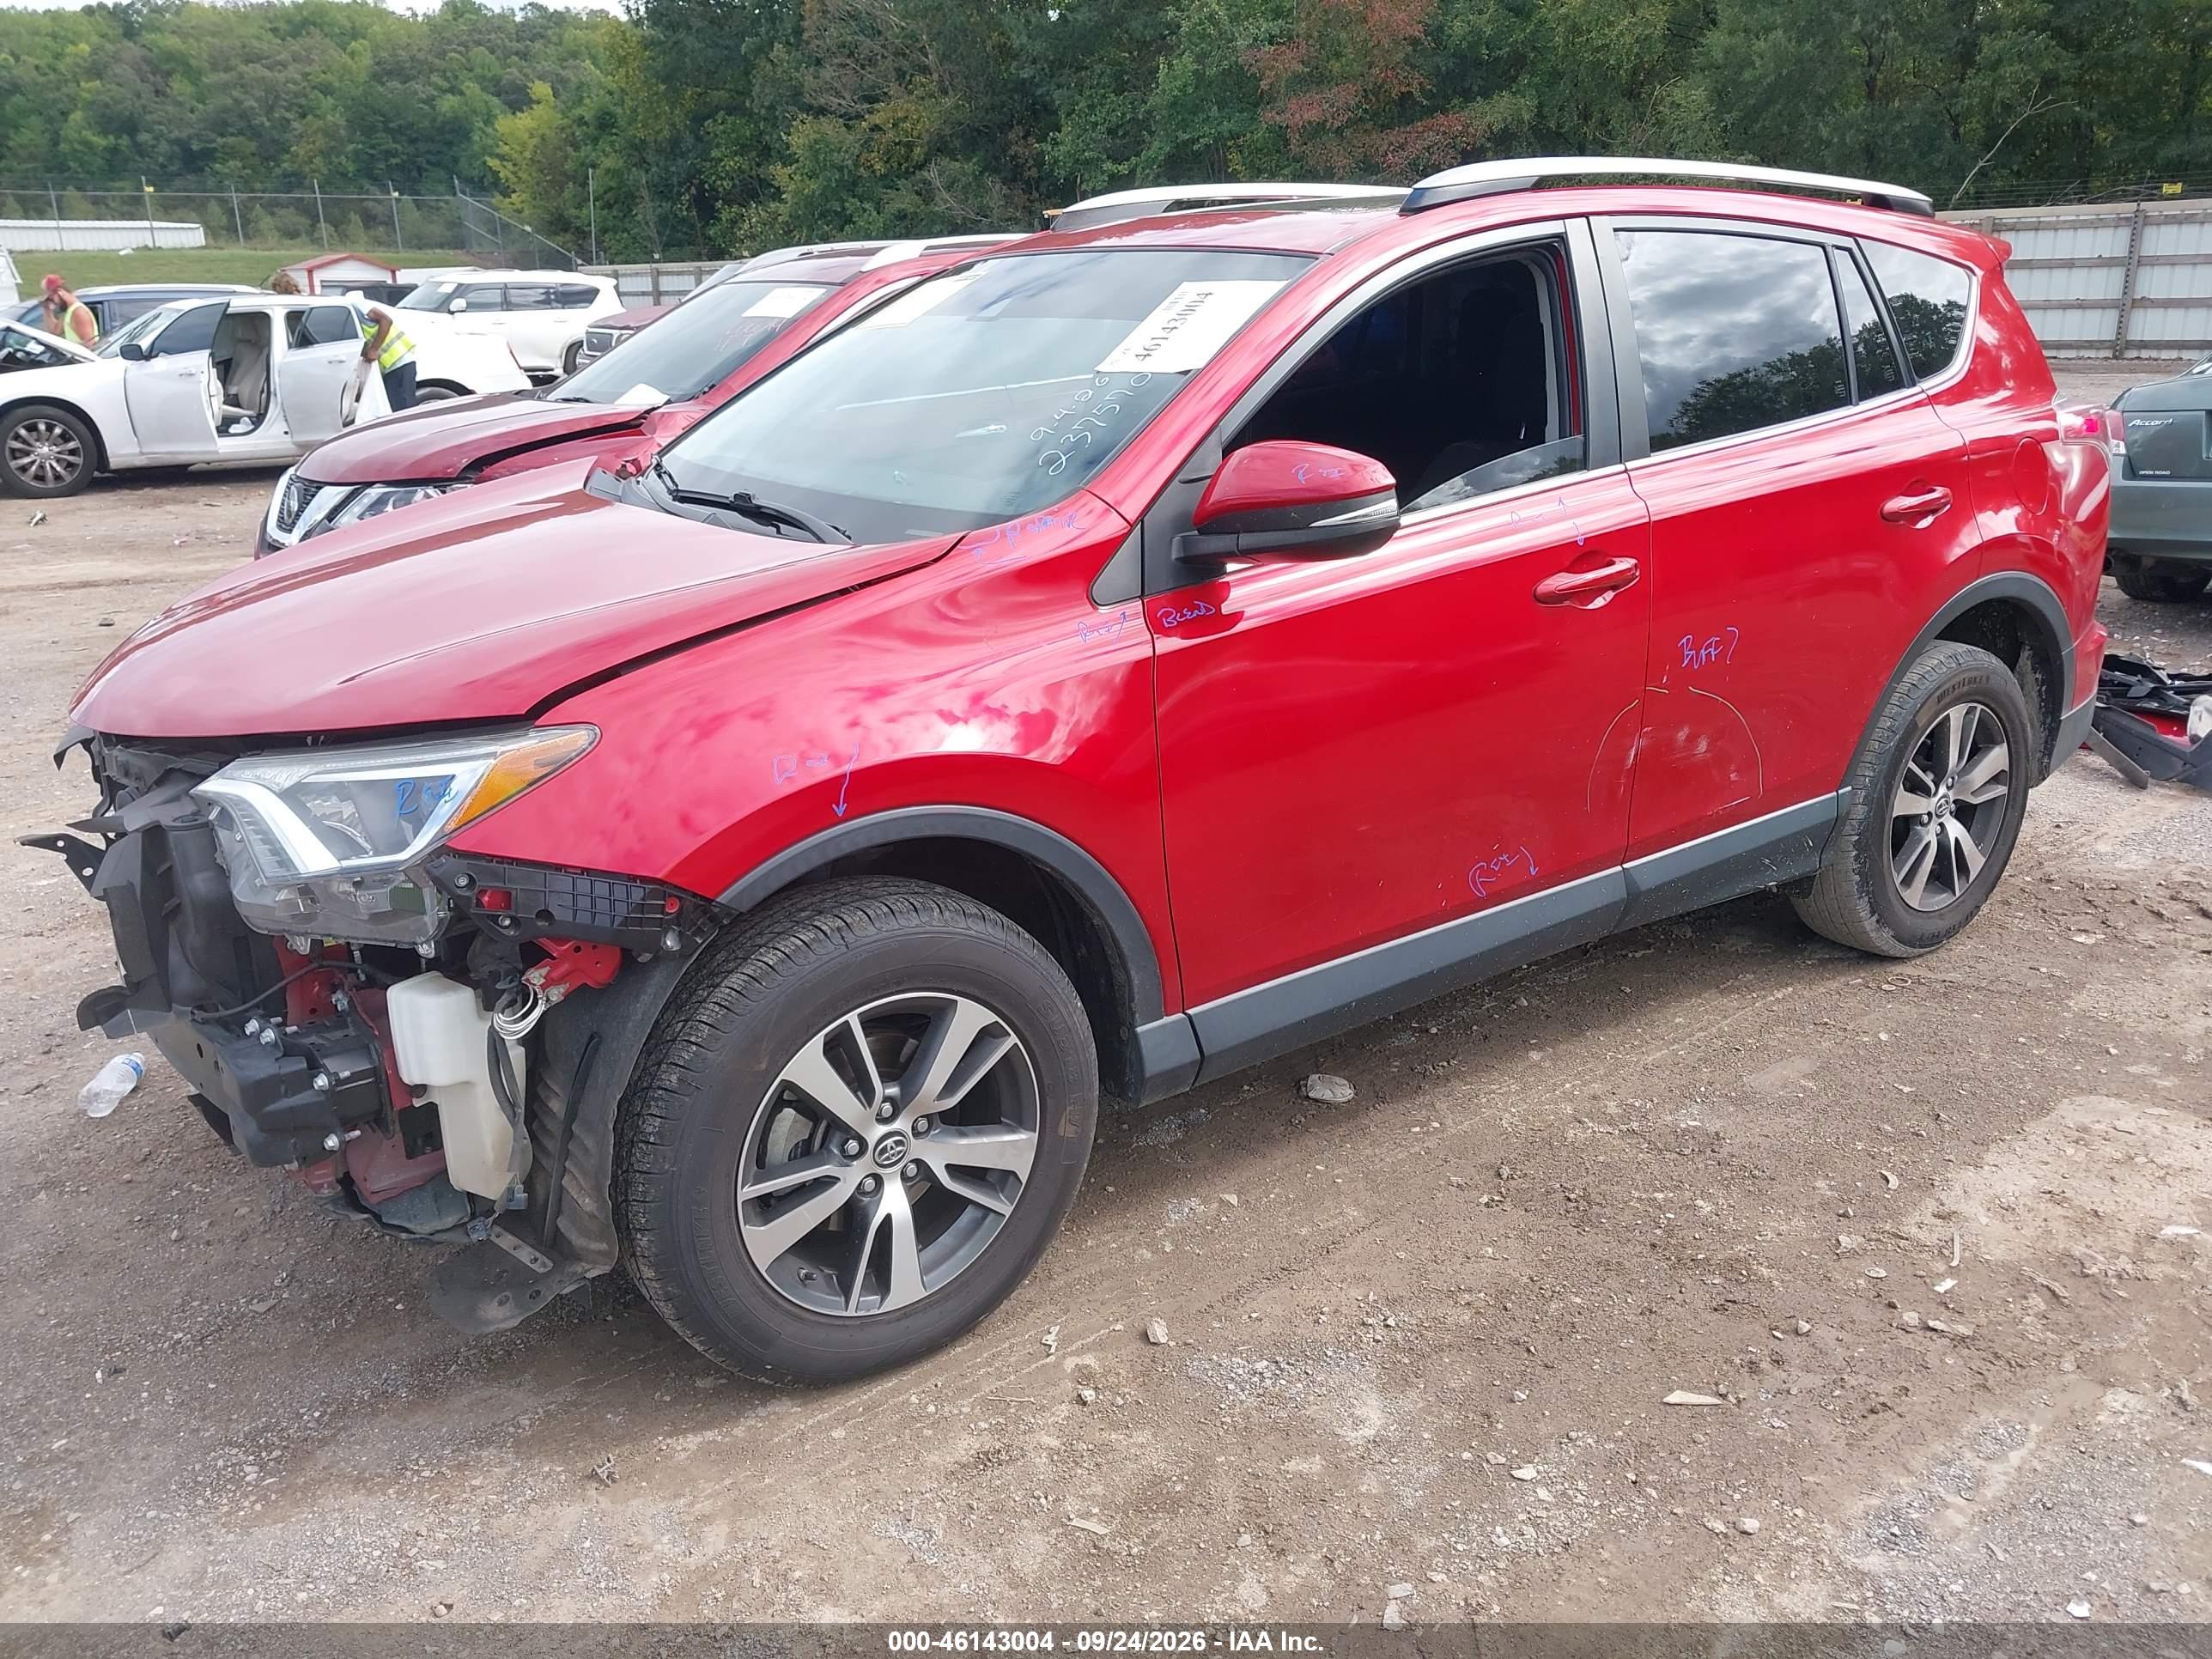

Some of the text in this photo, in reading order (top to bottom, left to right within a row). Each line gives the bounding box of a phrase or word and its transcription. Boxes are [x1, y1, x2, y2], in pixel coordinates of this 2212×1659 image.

[1133, 291, 1216, 362] 46143004
[1038, 372, 1152, 476] 237570
[2128, 417, 2174, 427] Accord
